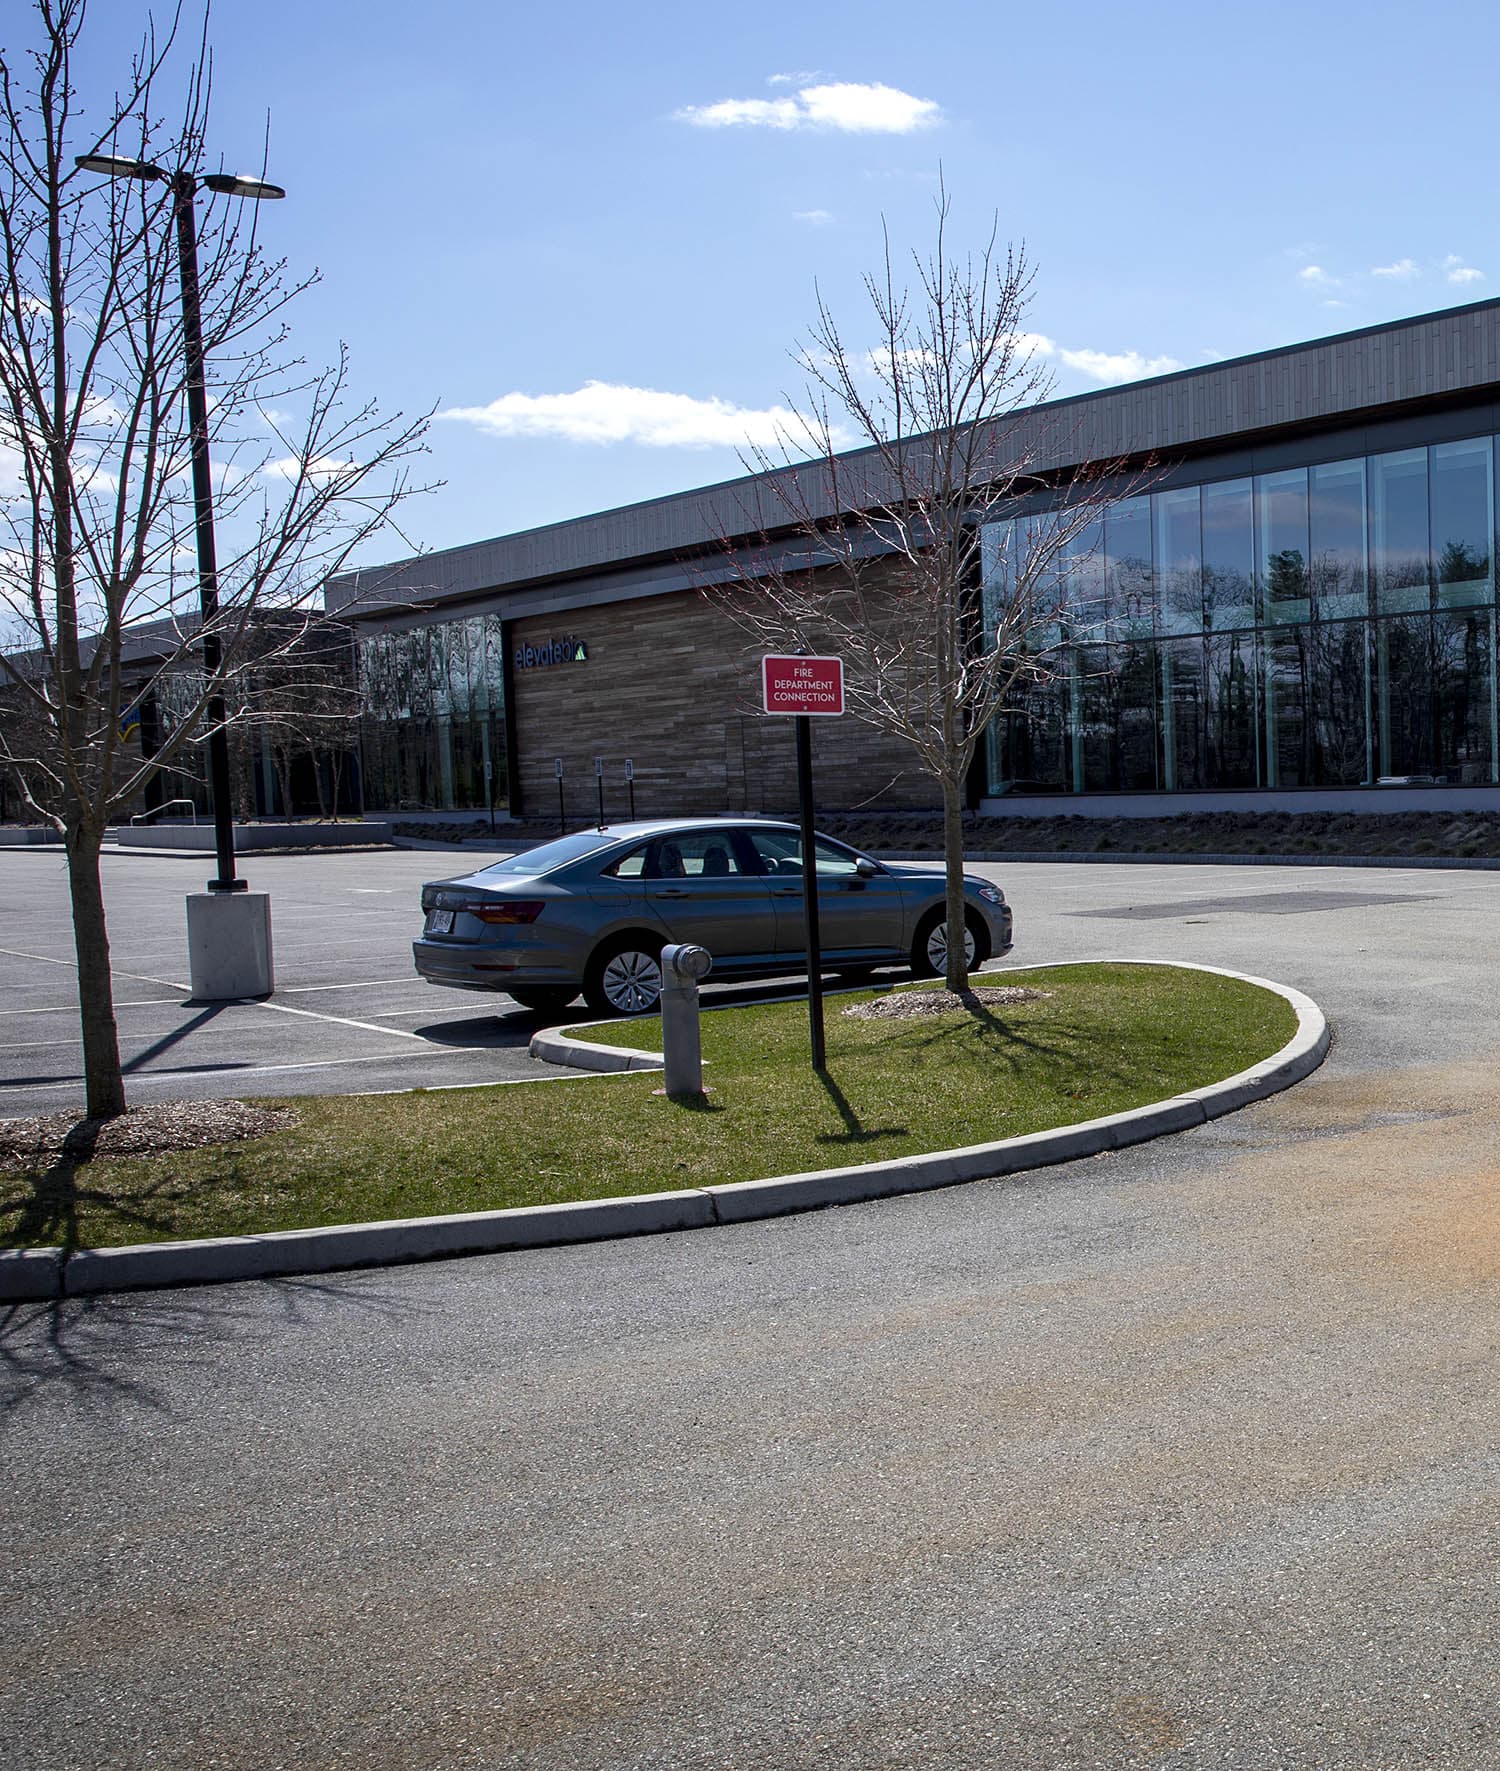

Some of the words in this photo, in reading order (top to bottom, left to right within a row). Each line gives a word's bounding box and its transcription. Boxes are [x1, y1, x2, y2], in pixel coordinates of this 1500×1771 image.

[793, 668, 813, 678] FIRE
[774, 680, 833, 690] DEPARTMENT
[773, 692, 835, 702] CONNECTION
